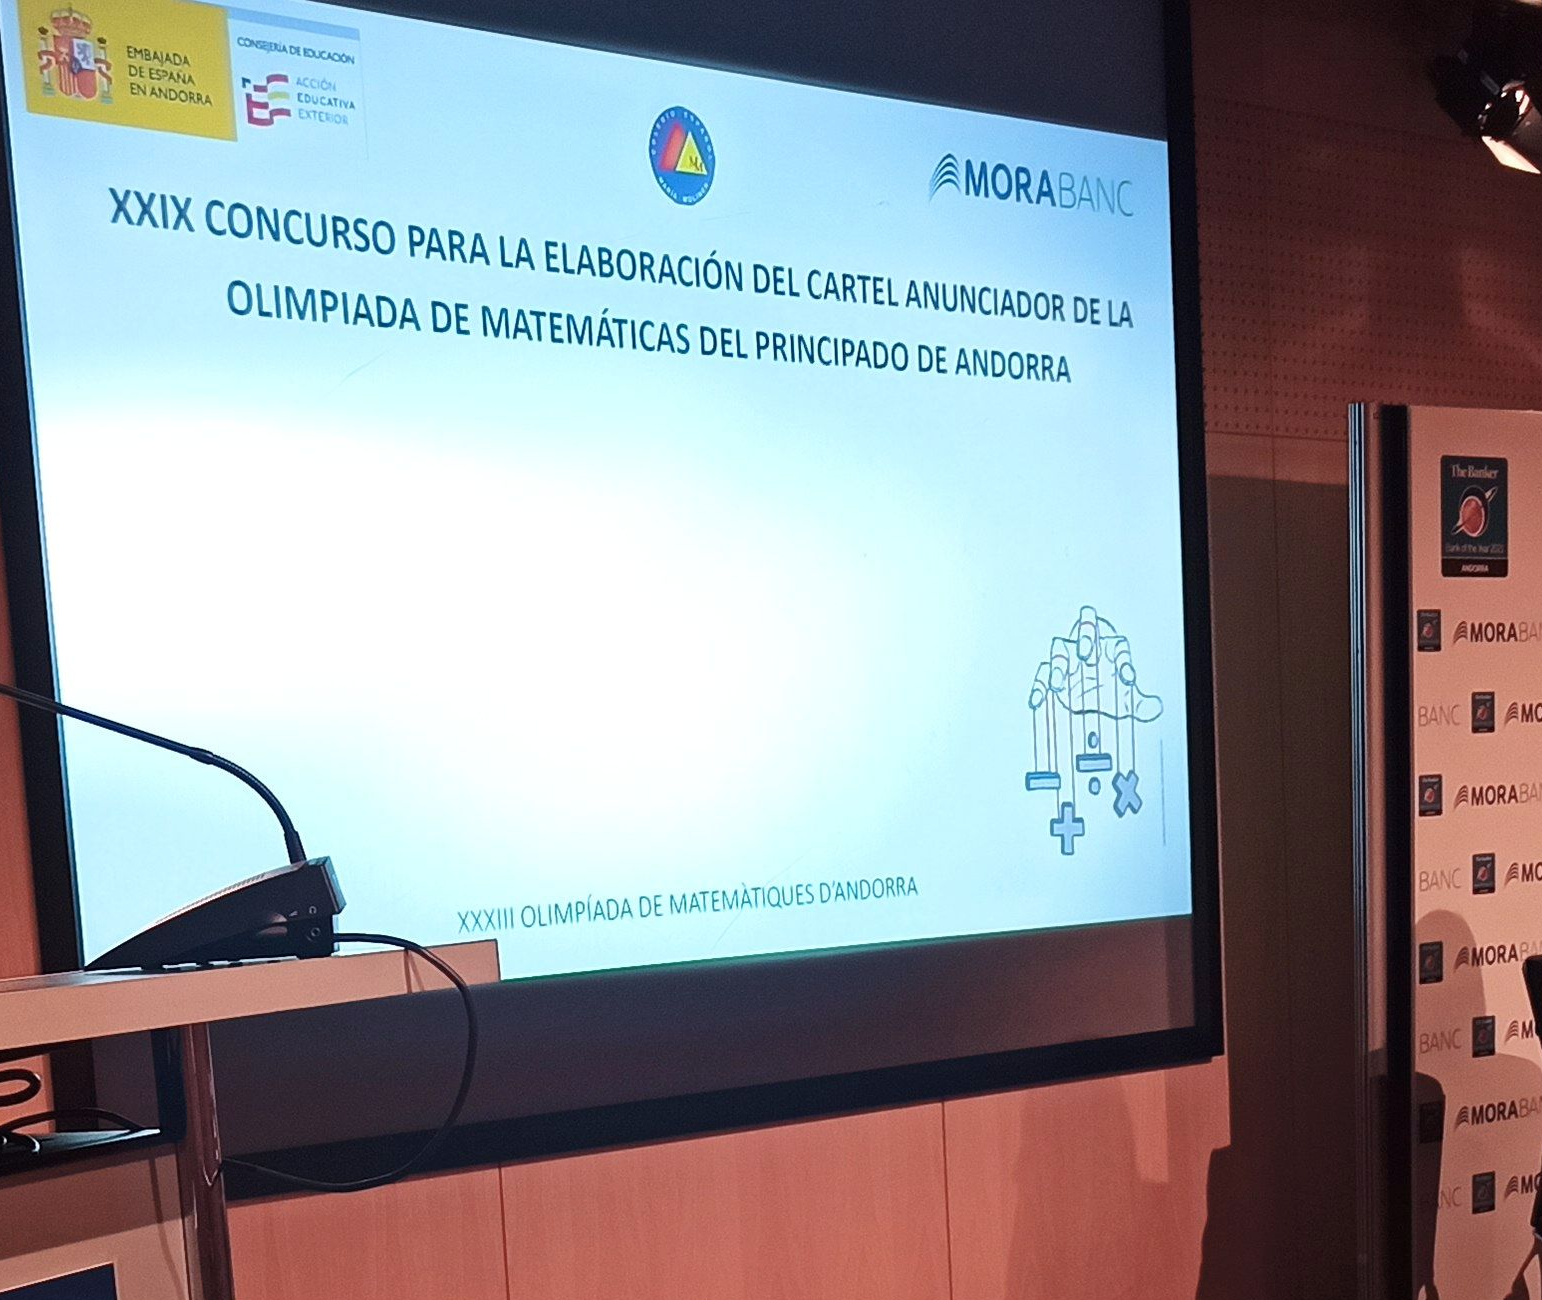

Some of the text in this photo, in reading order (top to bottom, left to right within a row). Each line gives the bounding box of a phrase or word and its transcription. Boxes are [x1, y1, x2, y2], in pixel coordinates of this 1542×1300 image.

[126, 45, 191, 68] EMBAJADA
[237, 36, 355, 65] CONSEJERÍA DE EDUCACIÓN
[128, 65, 195, 86] DE ESPAÑA
[296, 76, 337, 92] ACCIÓN
[130, 83, 213, 107] EN ANDORRA
[297, 92, 356, 110] EDUCATIVA
[298, 108, 349, 125] EXTERIOR
[964, 158, 1135, 218] MORABANC
[109, 186, 1135, 329] XXIX CONCURSO PARA LA ELABORACIÓN DEL CARTEL ANUNCIADOR DE LA
[227, 279, 1072, 383] OLIMPIADA DE MATEMÁTICAS DEL PRINCIPADO DE ANDORRA
[1418, 703, 1462, 728] BANC
[1419, 868, 1462, 893] BANC
[457, 874, 919, 935] XXXIII OLIMPÍADA DE MATEMÀTIQUES D'ANDORRA
[1419, 1028, 1462, 1054] BANC
